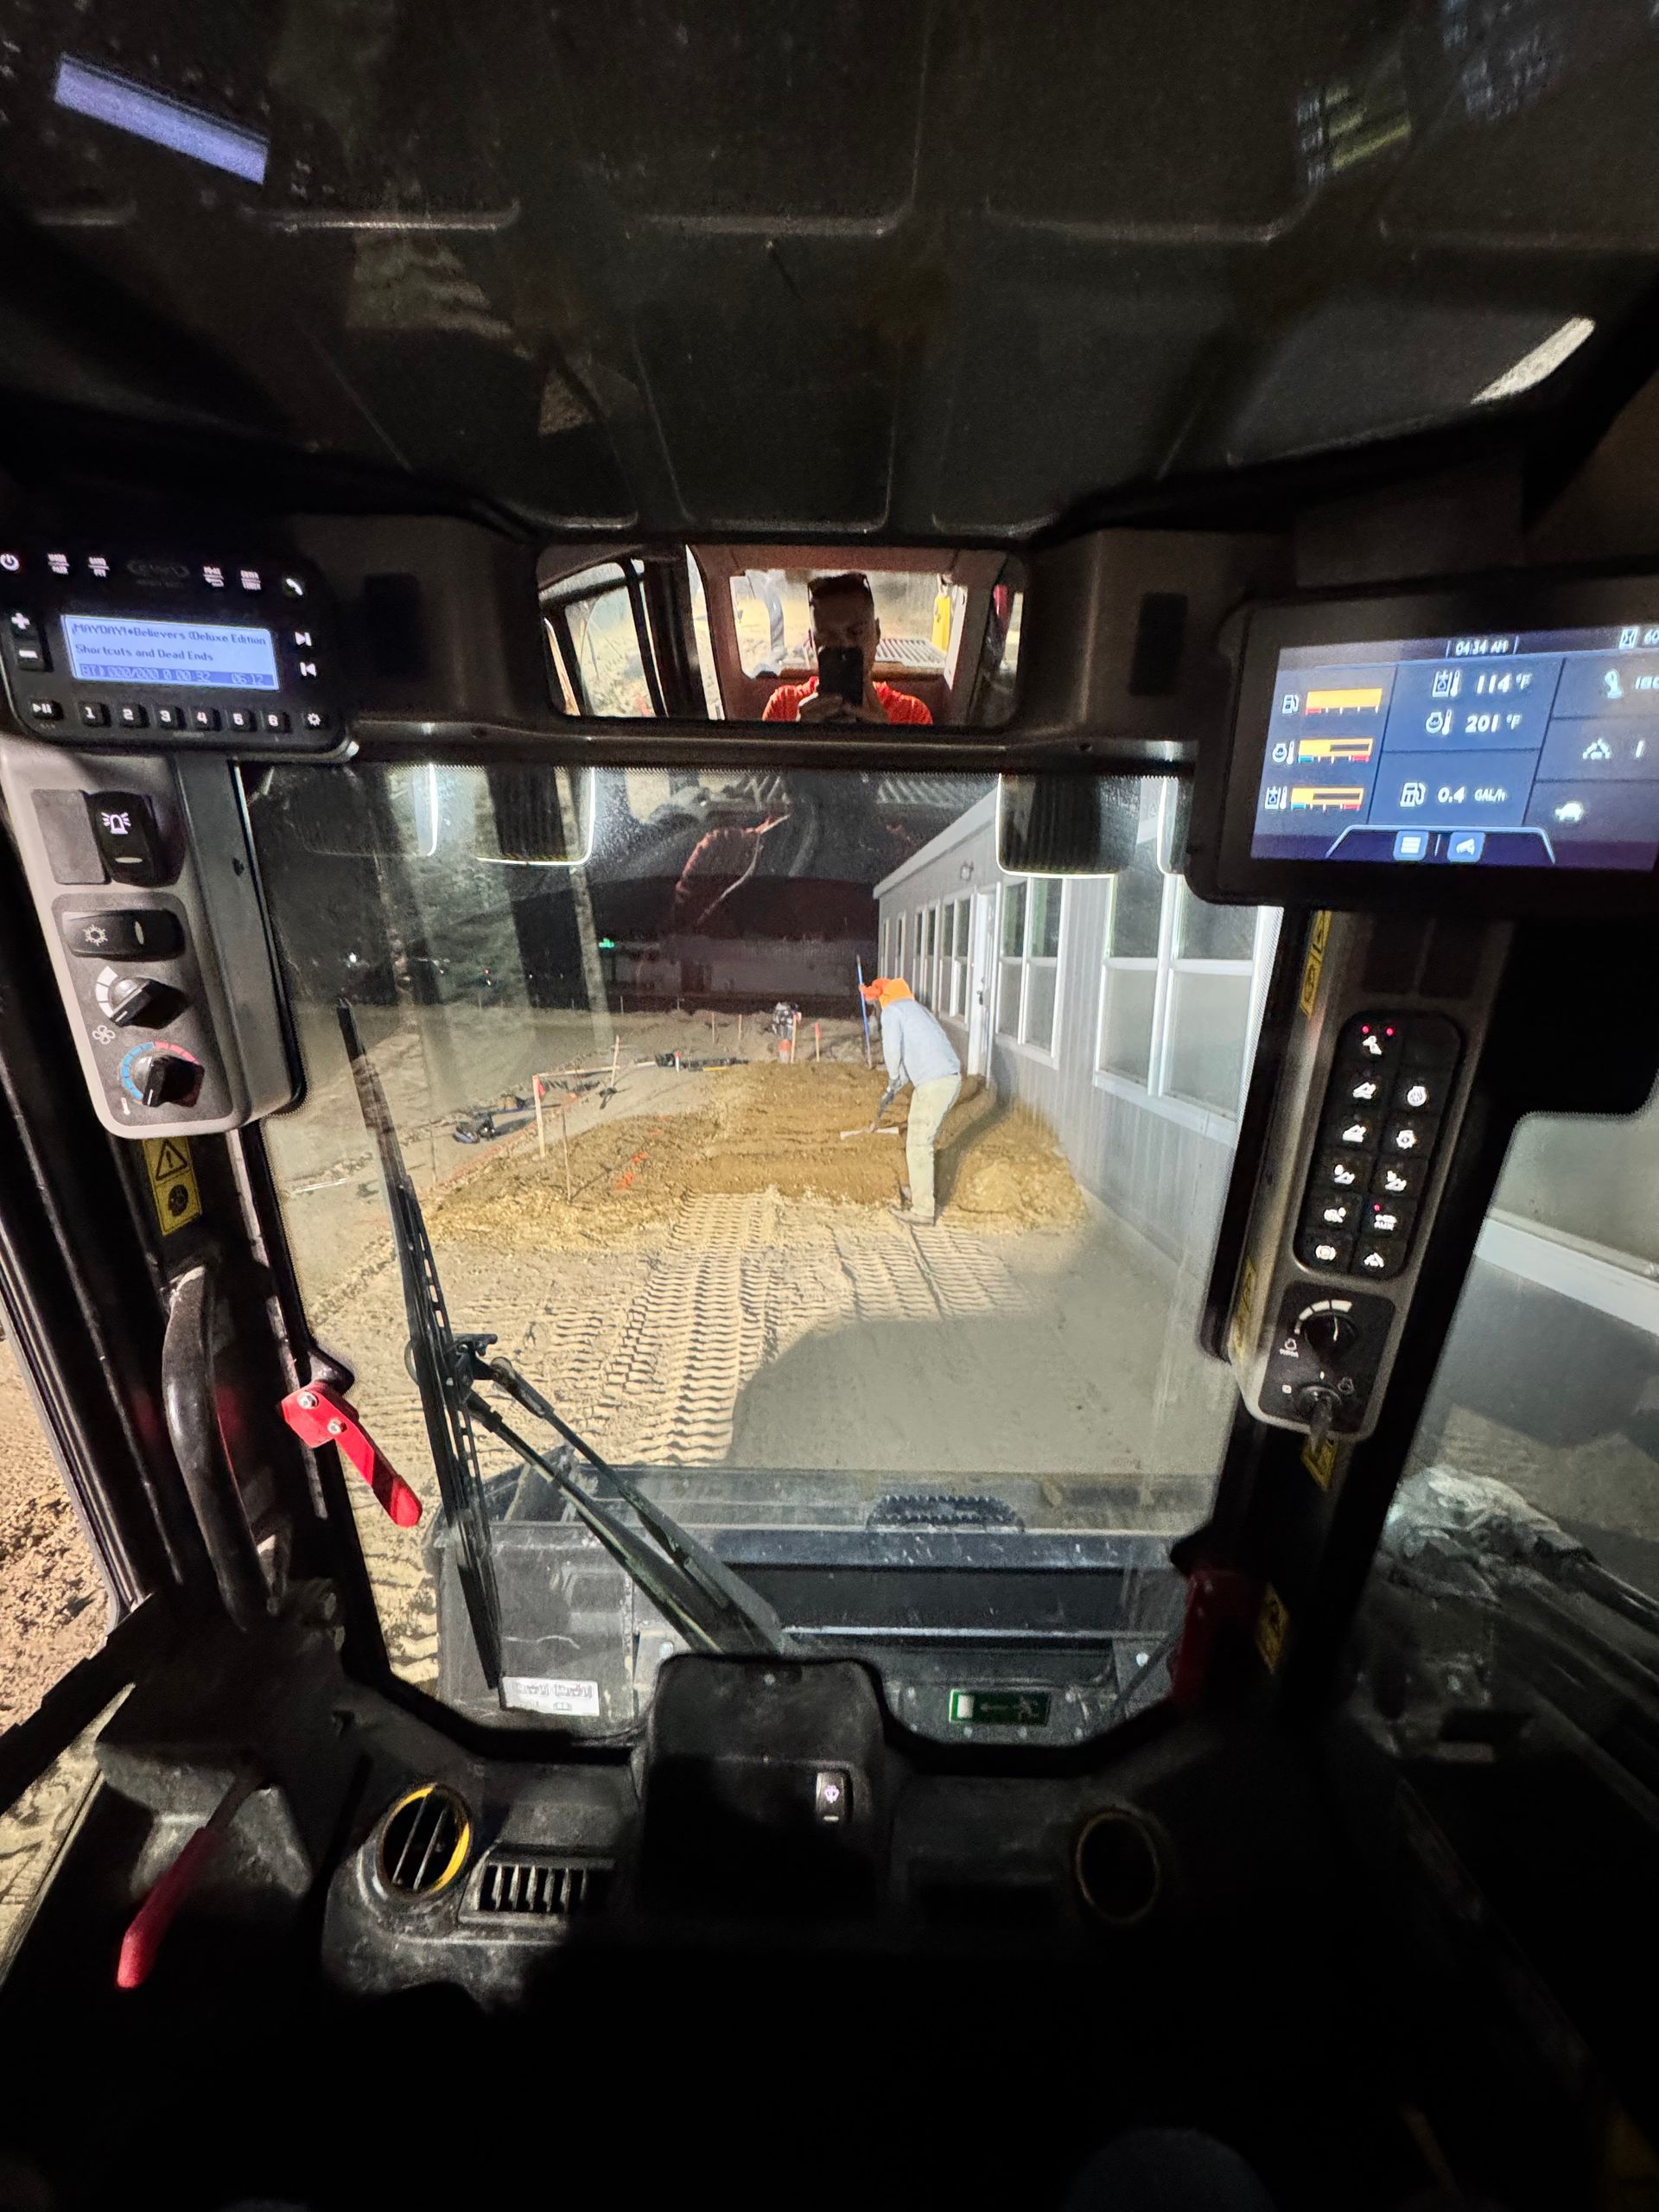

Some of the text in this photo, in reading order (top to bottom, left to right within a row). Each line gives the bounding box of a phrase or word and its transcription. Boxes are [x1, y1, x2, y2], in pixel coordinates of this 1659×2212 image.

[231, 633, 266, 645] Edition
[75, 644, 213, 661] Shortcuts and Dead Ends
[1477, 674, 1512, 695] 114
[85, 706, 279, 727] 1 2 3 4 5 6
[1465, 714, 1500, 734] 201
[1438, 786, 1465, 804] 0.4
